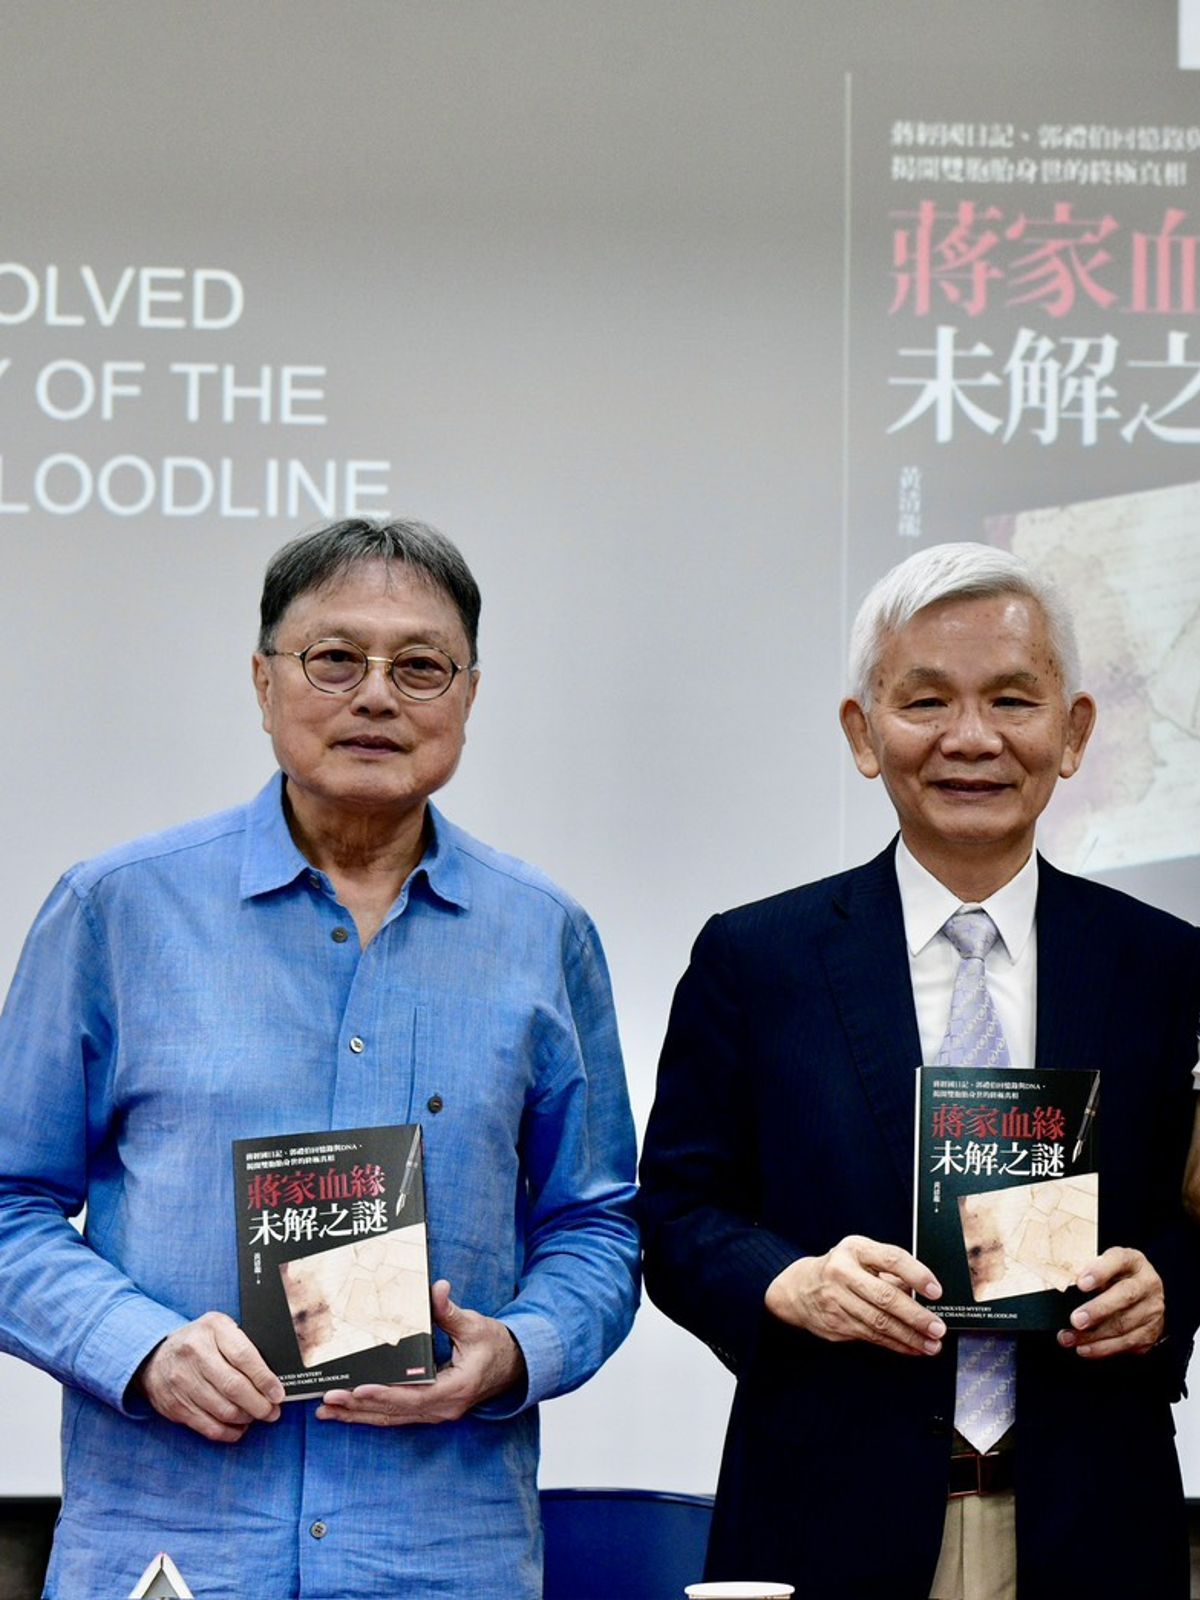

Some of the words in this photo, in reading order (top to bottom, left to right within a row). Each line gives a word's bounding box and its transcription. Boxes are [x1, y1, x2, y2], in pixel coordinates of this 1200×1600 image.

[36, 360, 145, 420] OF
[170, 363, 327, 424] THE
[931, 1103, 1066, 1140] 蔣家血緣
[930, 1140, 1065, 1177] 未解之謎
[247, 1163, 386, 1210] 蔣家血緣
[249, 1199, 388, 1245] 未解之謎
